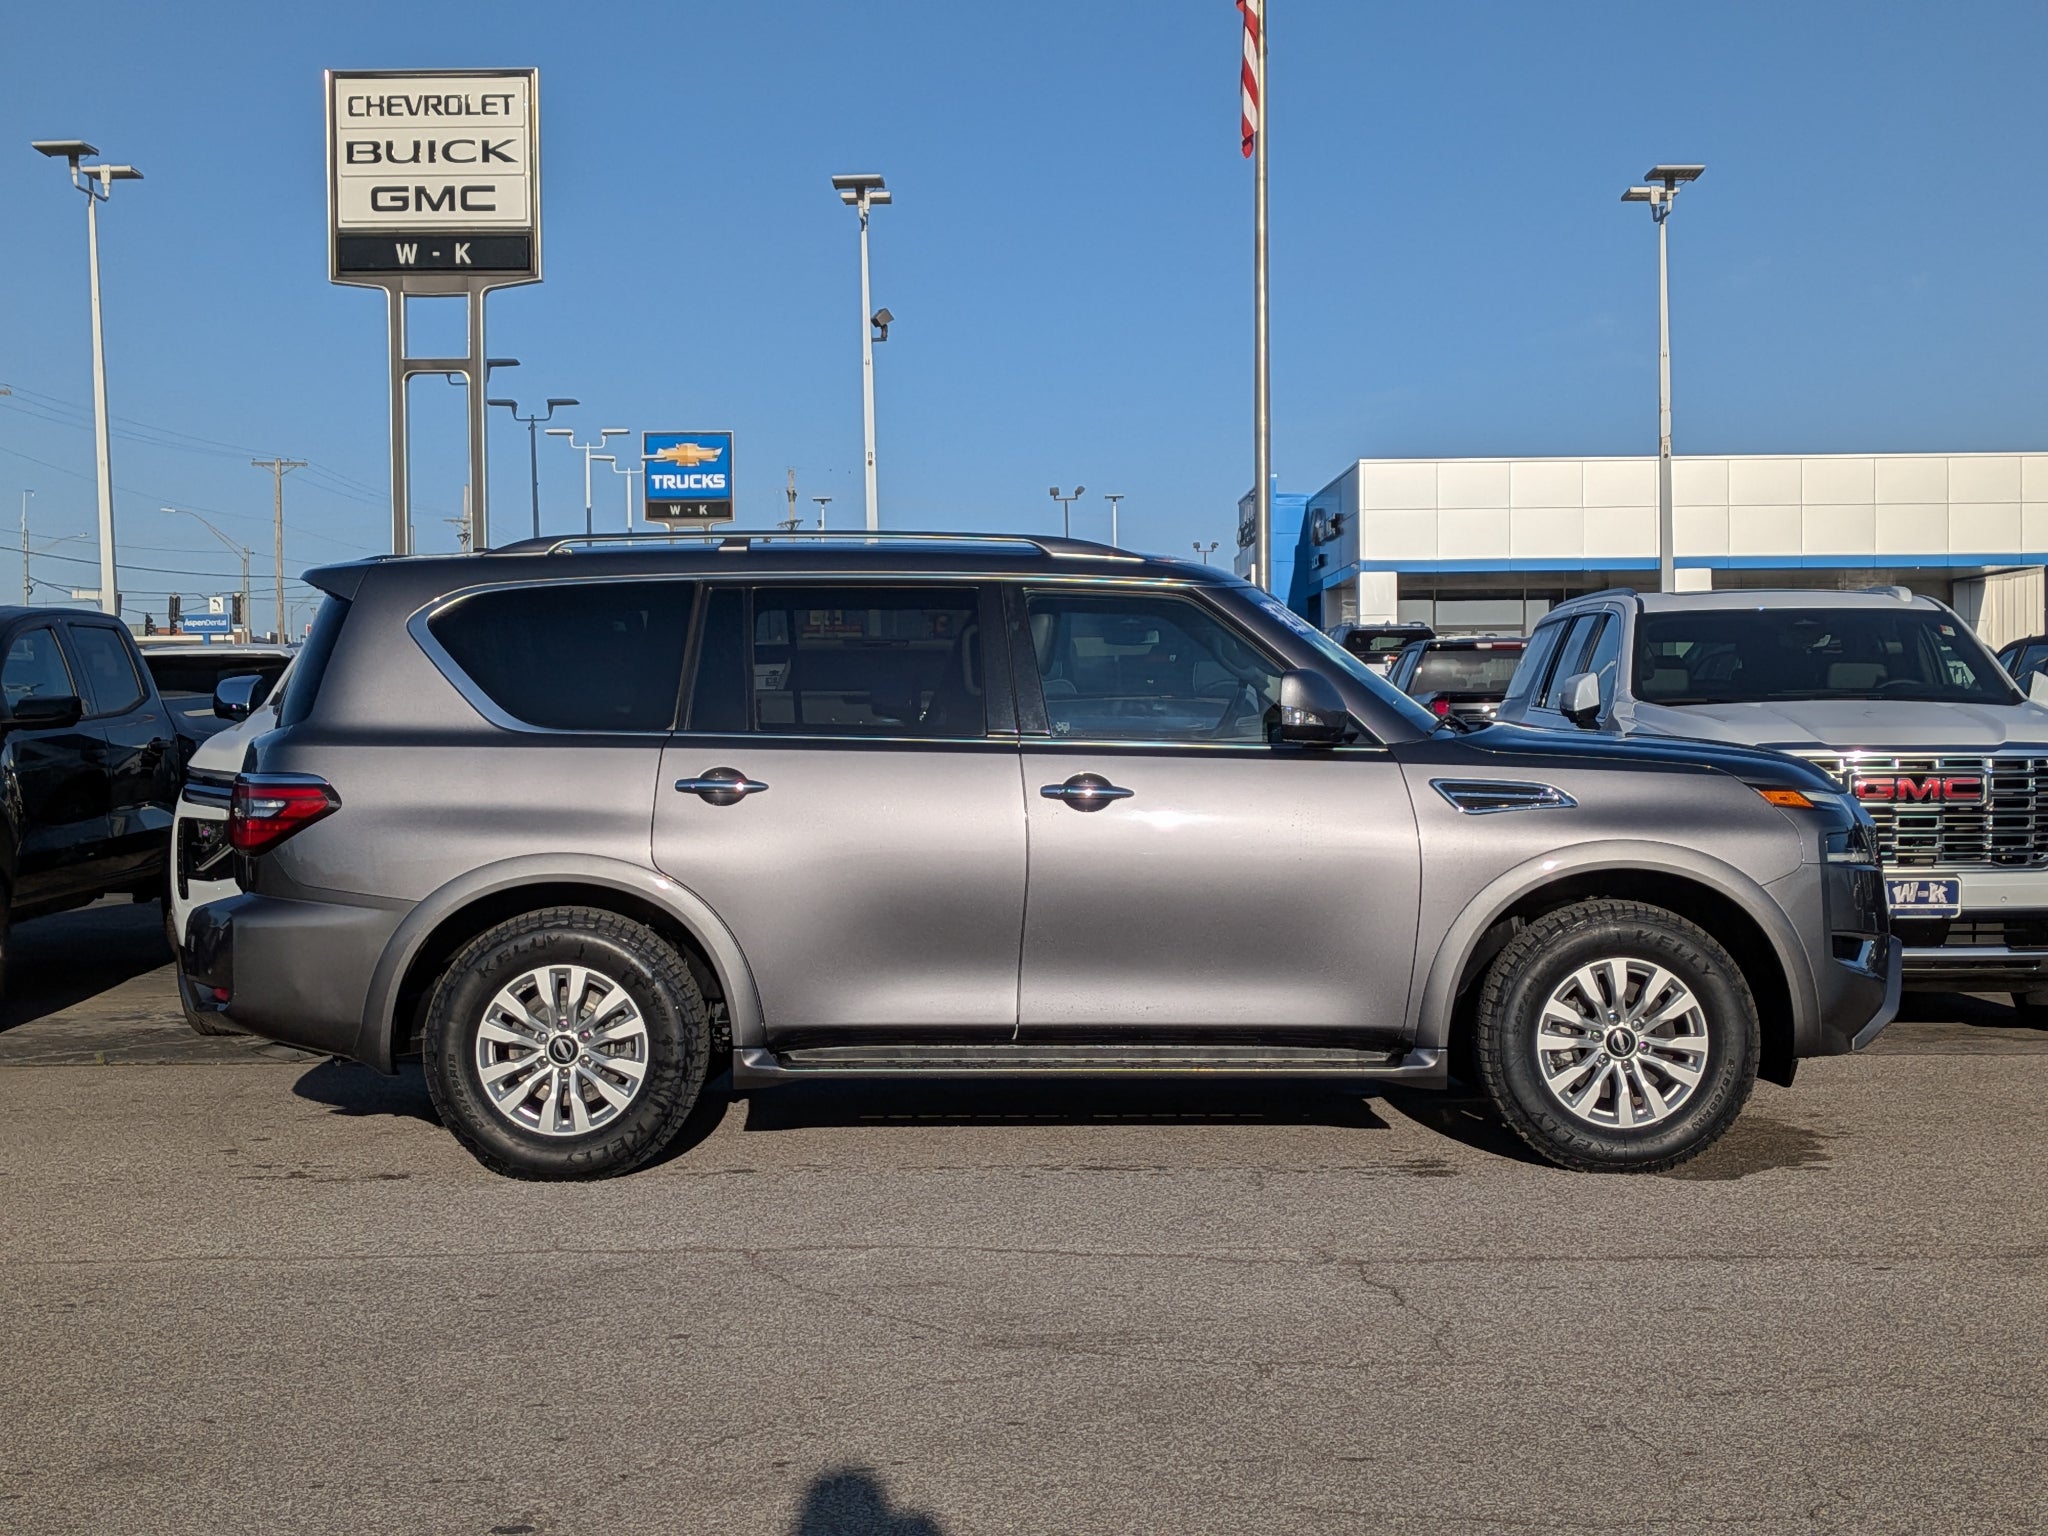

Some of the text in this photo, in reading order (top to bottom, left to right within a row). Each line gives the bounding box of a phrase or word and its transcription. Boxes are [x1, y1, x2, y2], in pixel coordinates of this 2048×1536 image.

[347, 94, 515, 117] CHEVROLET
[346, 138, 519, 164] BUICK
[371, 185, 496, 212] GMC
[651, 473, 726, 489] TRUCKS
[1854, 776, 1982, 800] GMC
[1892, 881, 1949, 904] W-K
[1634, 929, 1717, 975] KELLY
